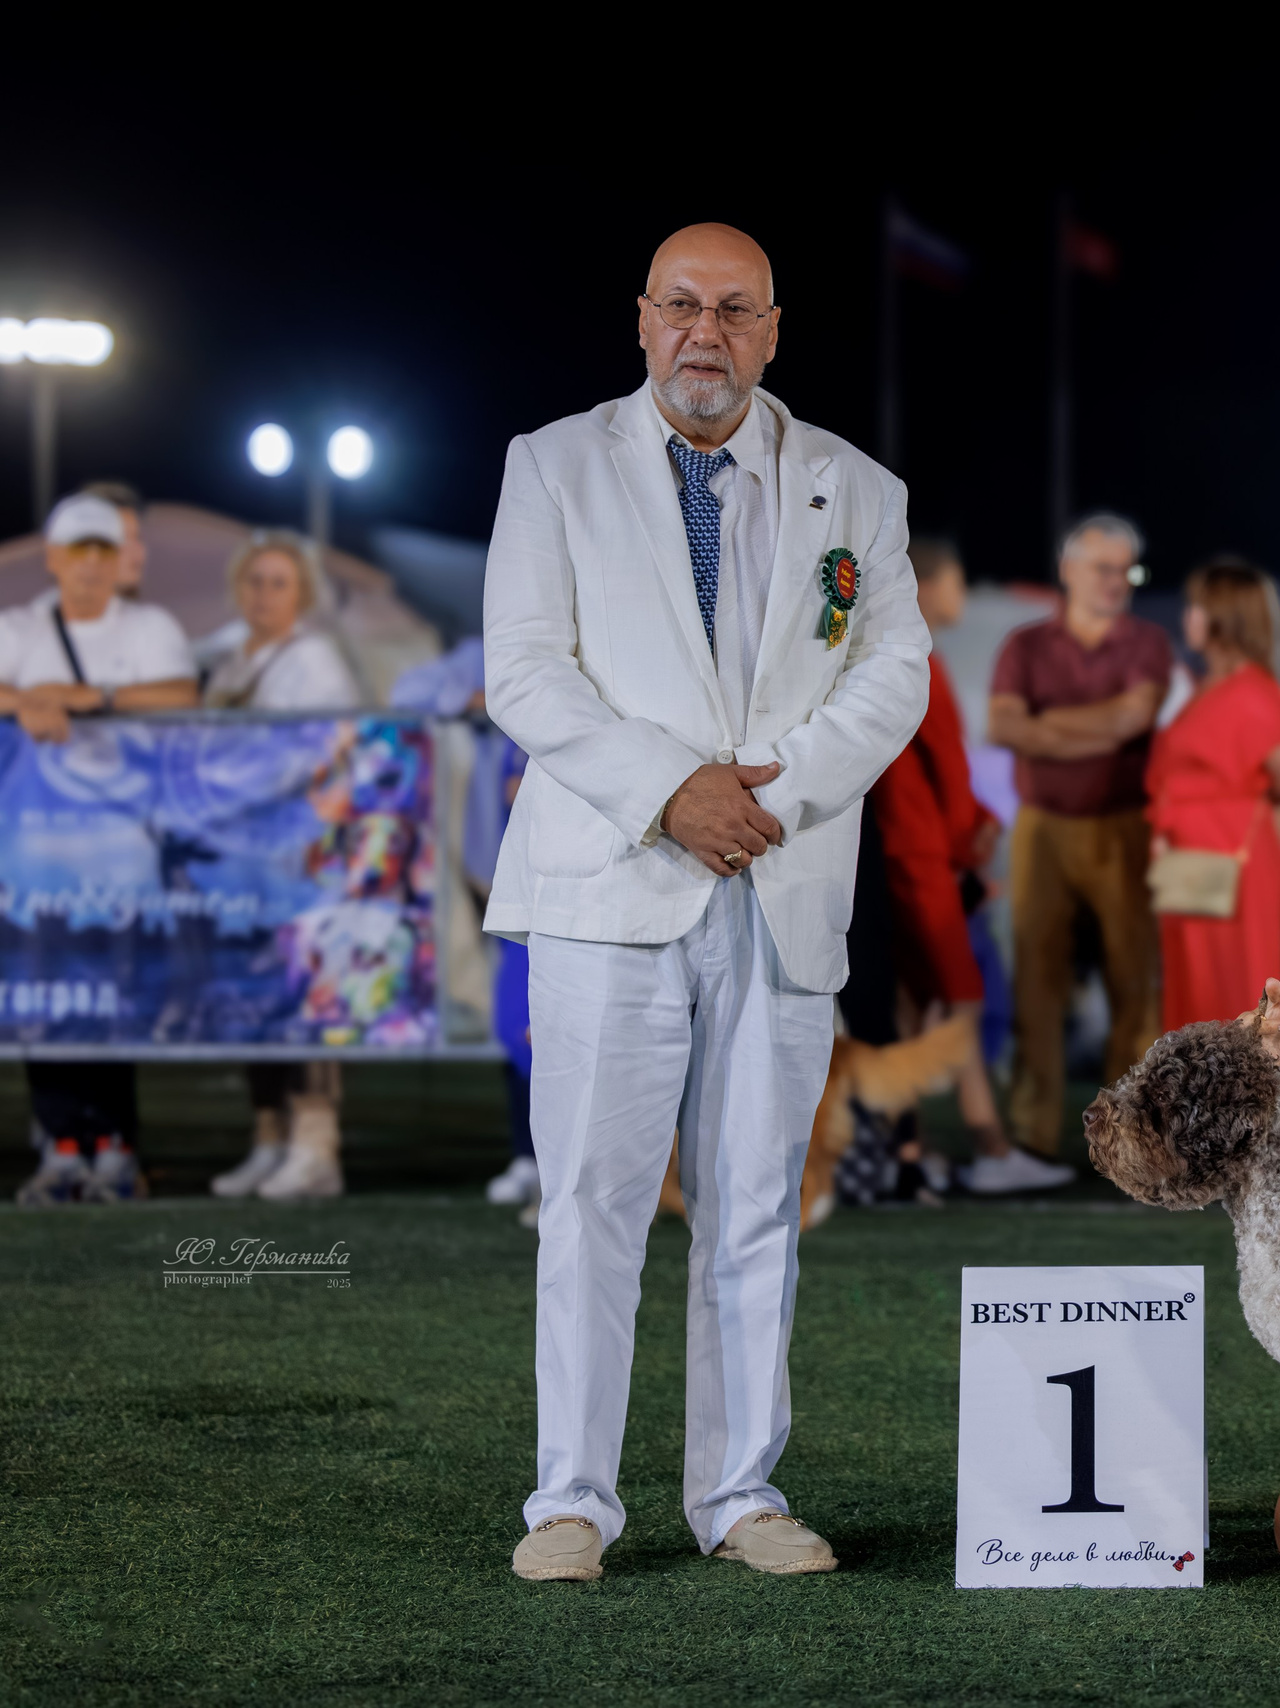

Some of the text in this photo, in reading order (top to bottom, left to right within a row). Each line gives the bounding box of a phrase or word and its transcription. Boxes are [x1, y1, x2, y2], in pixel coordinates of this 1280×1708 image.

[970, 1300, 1188, 1323] BEST DINNER
[1042, 1364, 1125, 1513] 1
[976, 1539, 1024, 1565] Все
[1030, 1550, 1079, 1572] дело
[1086, 1542, 1098, 1562] в
